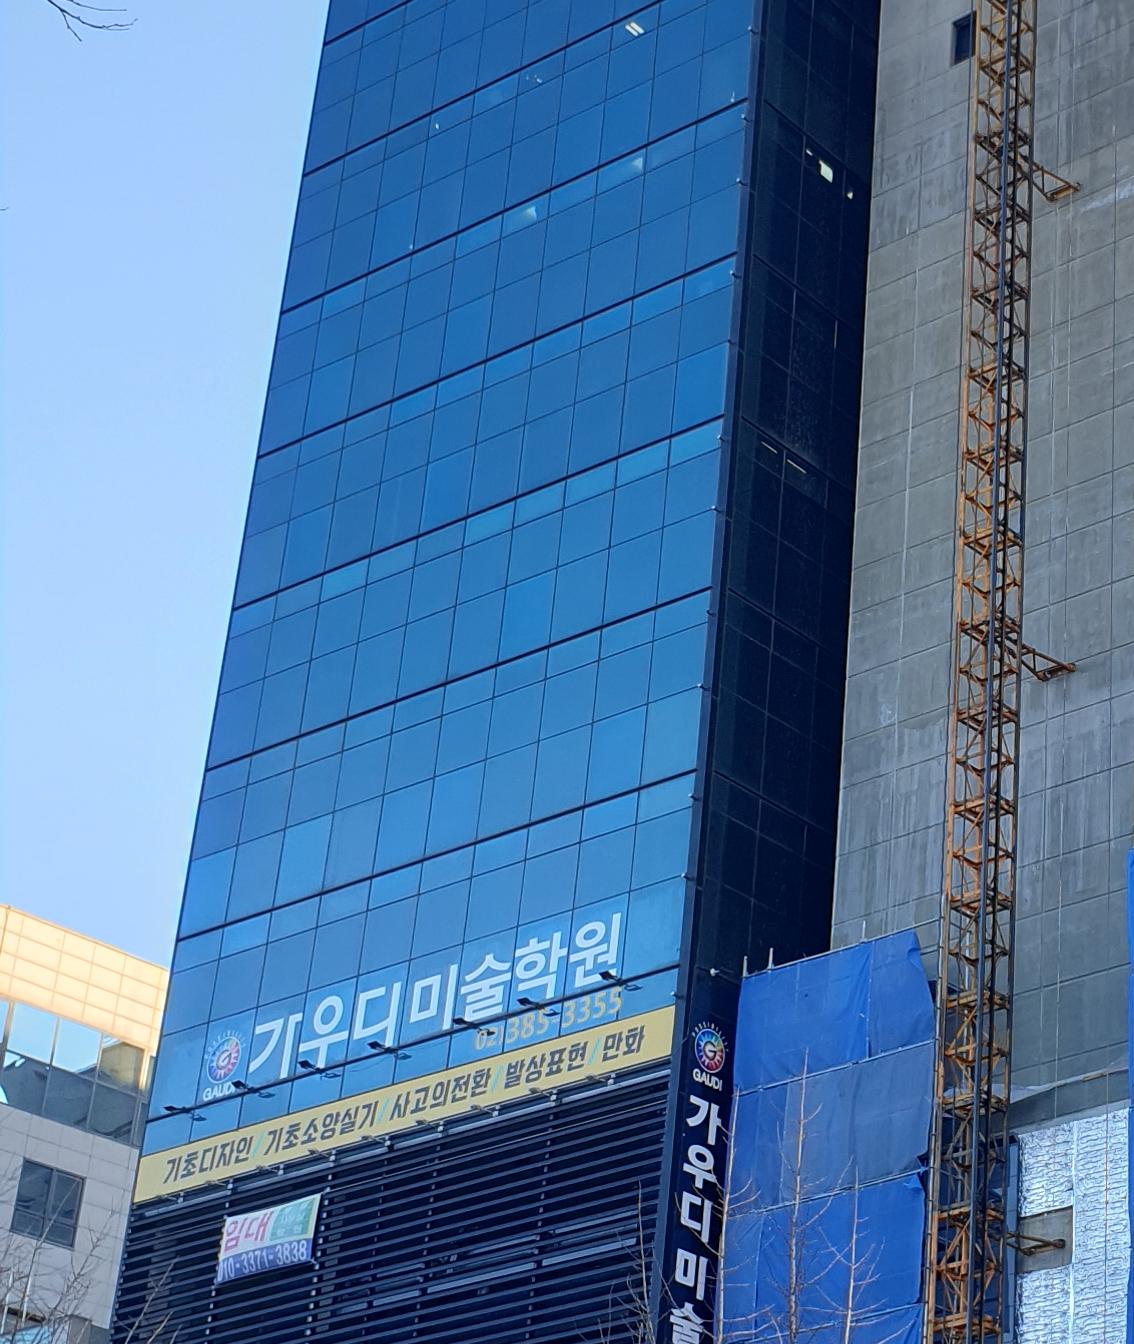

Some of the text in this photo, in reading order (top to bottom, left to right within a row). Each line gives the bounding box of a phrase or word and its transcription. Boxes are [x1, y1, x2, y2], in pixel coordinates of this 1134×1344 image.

[249, 912, 621, 1079] 가우디미술학원
[693, 1068, 722, 1092] GAUDI
[163, 1024, 645, 1184] 기초디자인 기초소양실기 사고의전환 발상표현 만화
[225, 1211, 275, 1253] 임대
[217, 1239, 307, 1282] 010-3371-3838
